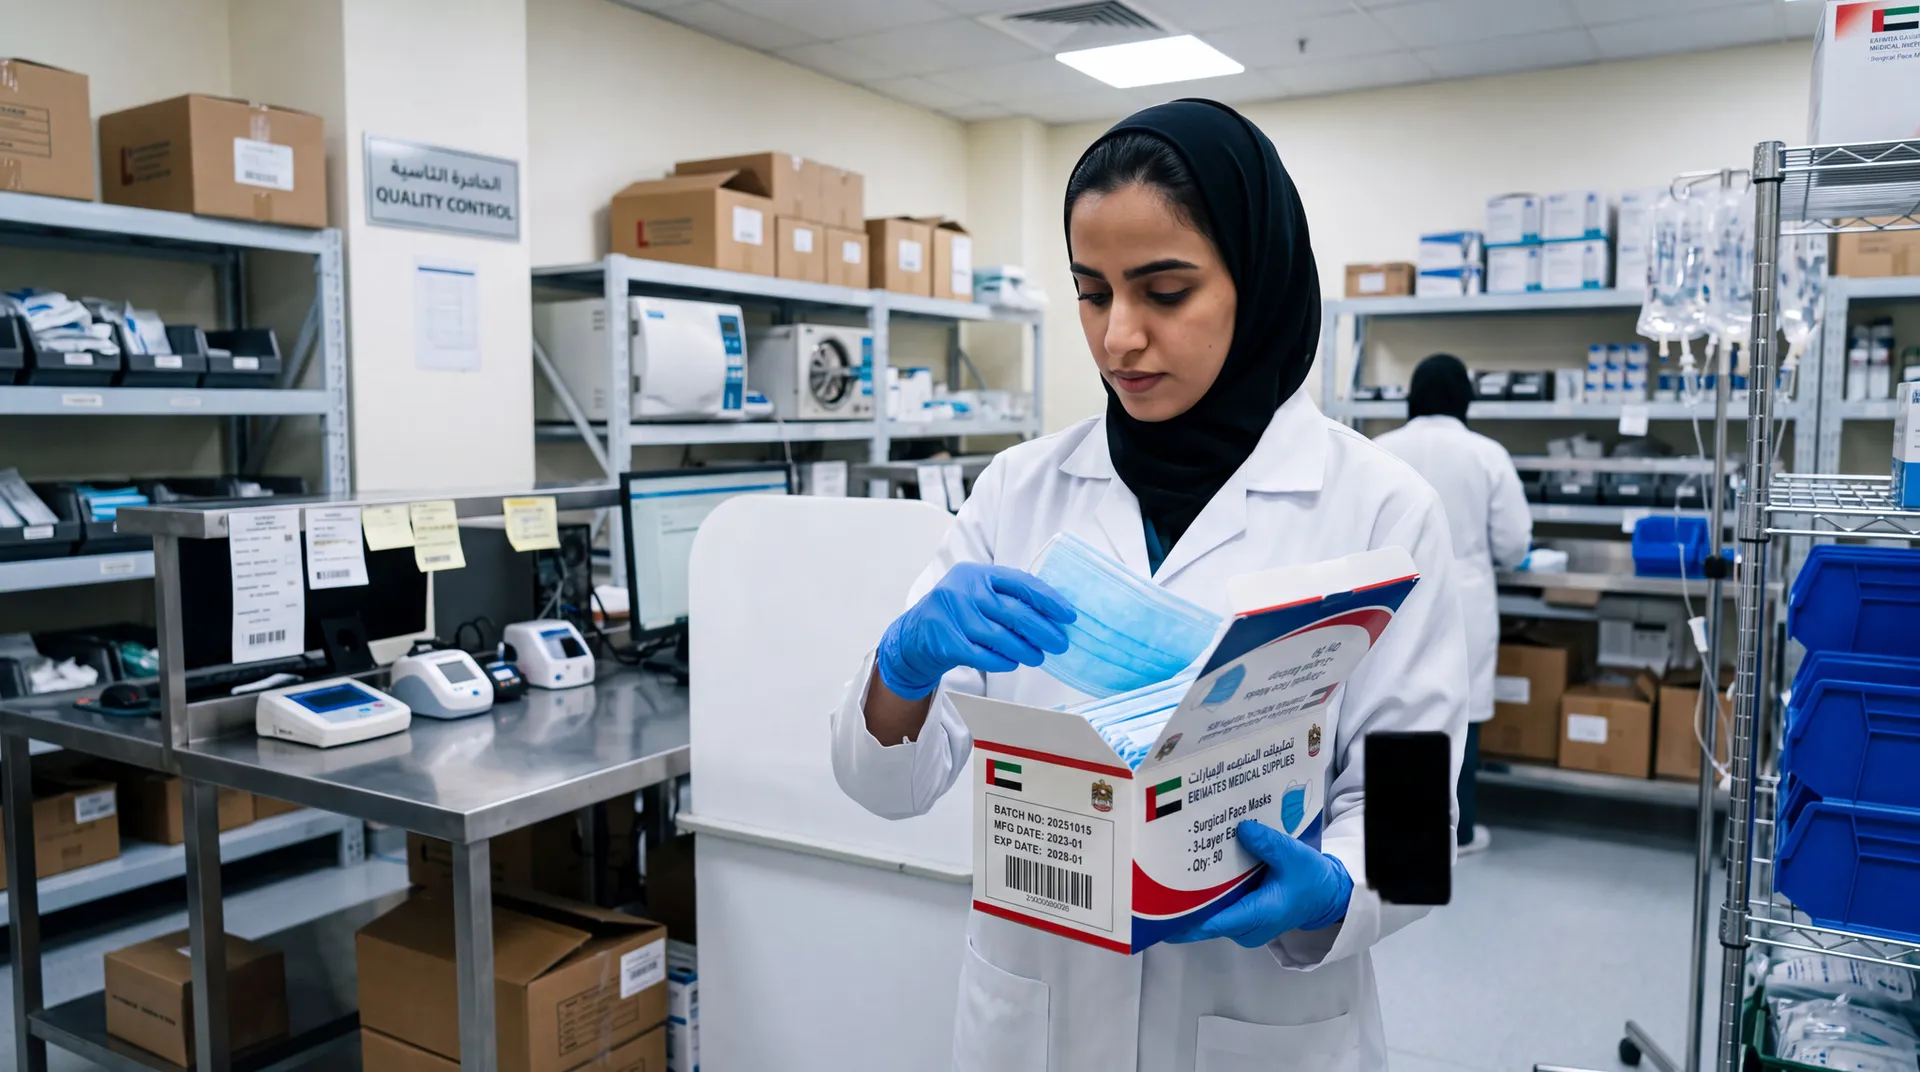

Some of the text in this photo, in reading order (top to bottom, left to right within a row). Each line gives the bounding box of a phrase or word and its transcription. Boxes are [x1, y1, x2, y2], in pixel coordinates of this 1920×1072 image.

[376, 186, 515, 221] QUALITY CONTROL
[1228, 767, 1261, 789] MEDICAL
[1262, 753, 1295, 775] SUPPLIES
[994, 804, 1092, 835] BATCH NO: 20251015
[1193, 809, 1227, 834] Surgical
[1228, 805, 1247, 820] Face
[1248, 793, 1272, 812] Masks
[994, 819, 1083, 849] MFG DATE: 2023-01
[1192, 831, 1224, 853] 3-Layer
[994, 835, 1083, 865] EXP DATE: 2028-01
[1192, 849, 1223, 872] Qty: 50
